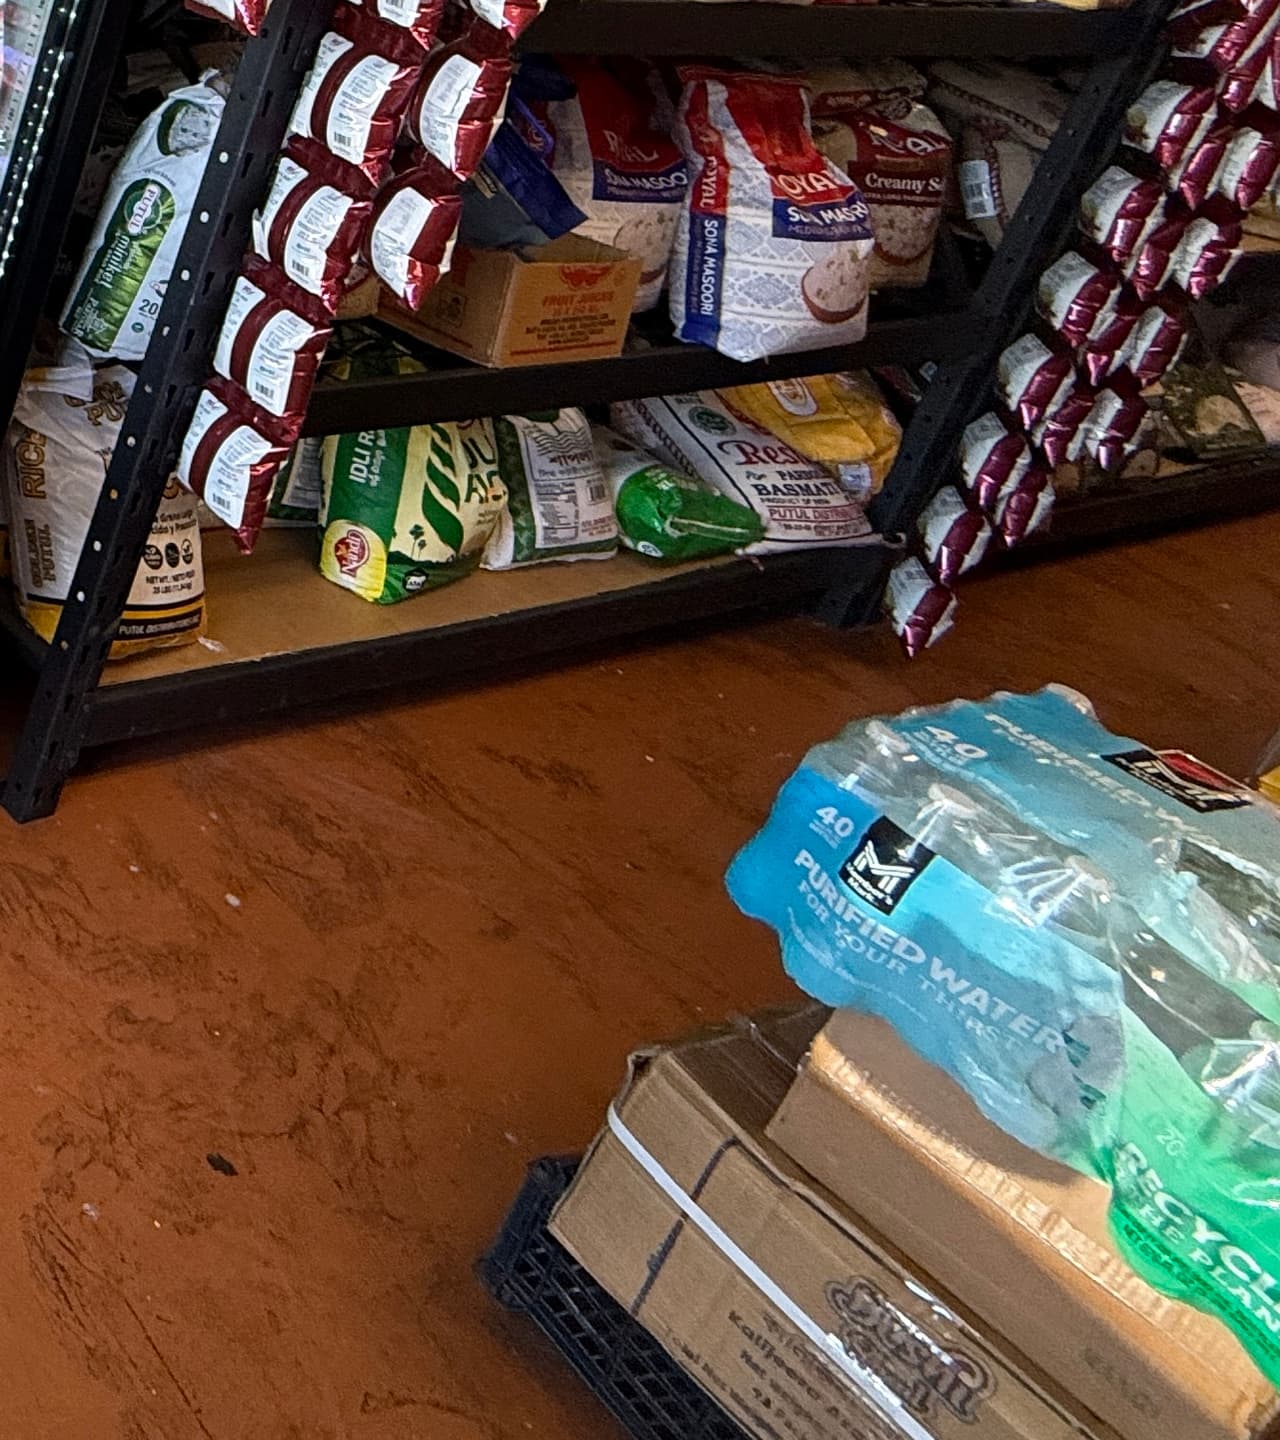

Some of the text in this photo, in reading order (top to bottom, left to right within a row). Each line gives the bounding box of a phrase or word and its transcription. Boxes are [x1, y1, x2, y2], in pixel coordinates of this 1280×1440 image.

[864, 172, 926, 194] Creamy
[127, 184, 158, 233] PUTUL
[699, 218, 718, 317] SONA MASOORI
[348, 451, 371, 486] IDLI
[339, 530, 370, 578] Nandi
[816, 805, 853, 839] 40
[794, 848, 927, 967] PURIFIED
[929, 956, 1066, 1054] WATER
[797, 884, 1018, 1054] FOR YOUR THIRST
[1138, 1196, 1185, 1246] THE
